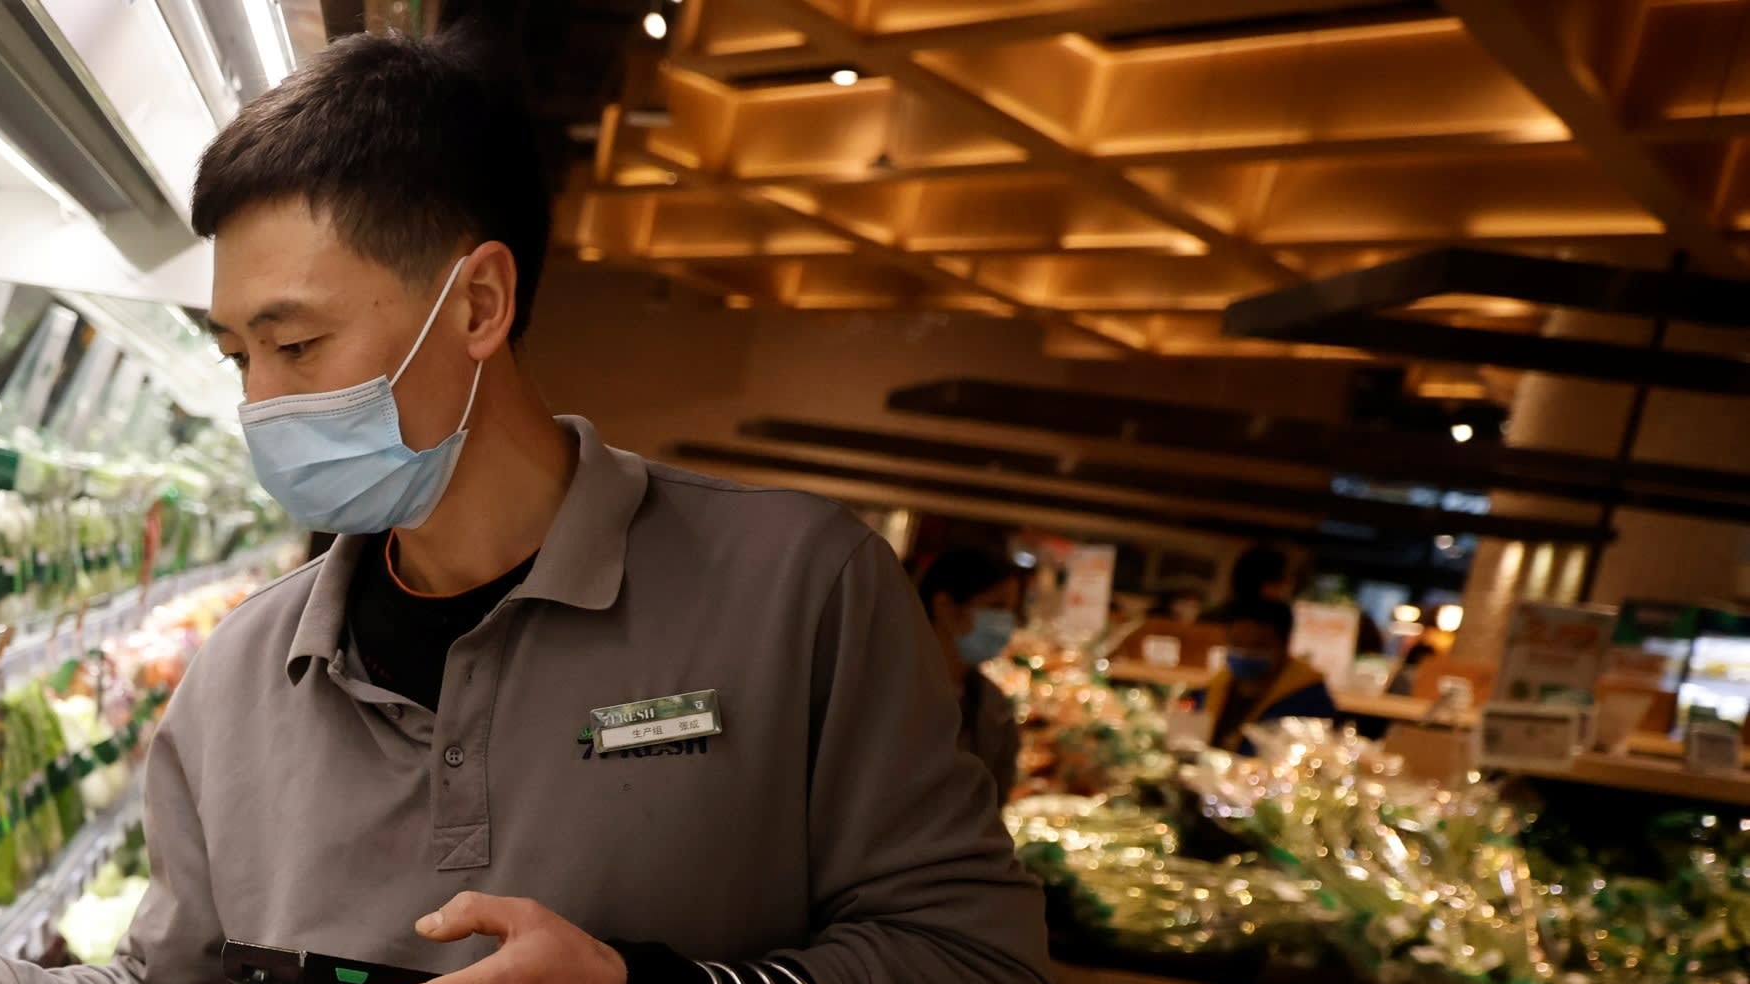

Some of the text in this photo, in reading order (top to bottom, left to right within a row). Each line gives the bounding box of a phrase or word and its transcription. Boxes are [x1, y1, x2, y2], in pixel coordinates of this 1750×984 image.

[602, 707, 655, 727] 7FRESH
[632, 725, 664, 738] 生产组
